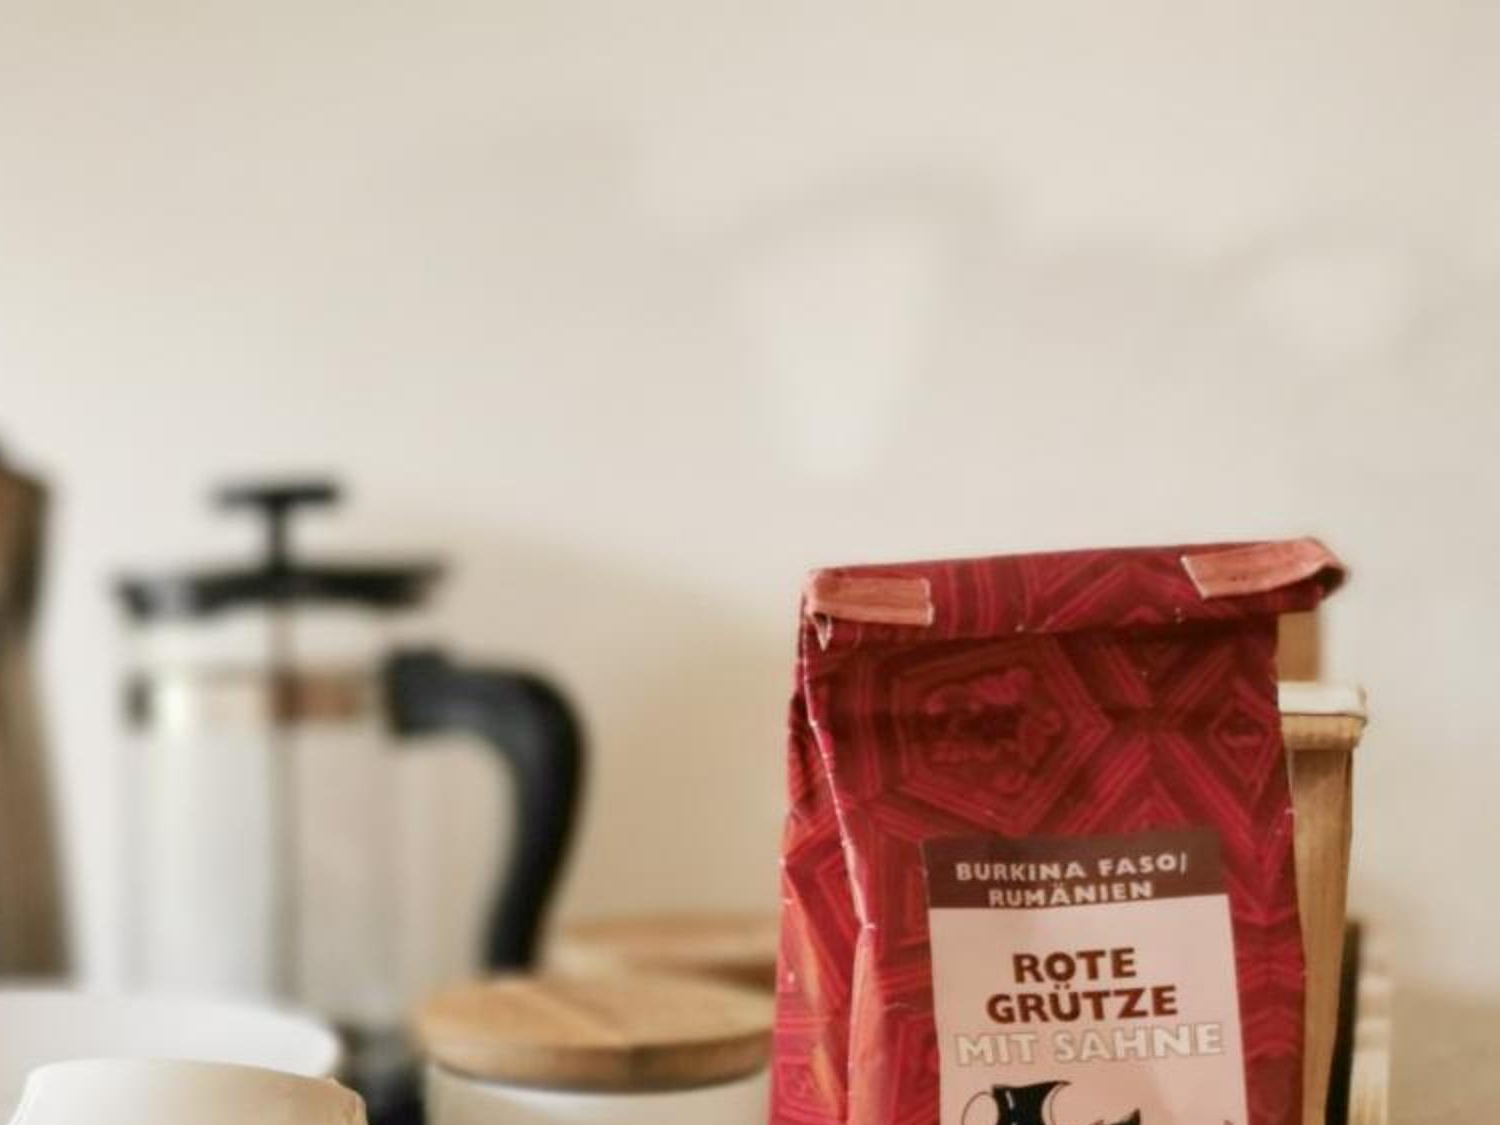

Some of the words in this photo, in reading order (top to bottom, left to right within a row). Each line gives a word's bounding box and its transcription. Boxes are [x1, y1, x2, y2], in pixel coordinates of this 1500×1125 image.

[955, 861, 1086, 881] BURKINA
[988, 881, 1153, 907] RUMÄNIEN
[1012, 947, 1136, 983] ROTE
[986, 984, 1178, 1024] GRÜTZE
[955, 1032, 1037, 1067] MIT
[1053, 1023, 1225, 1064] SAHNE
